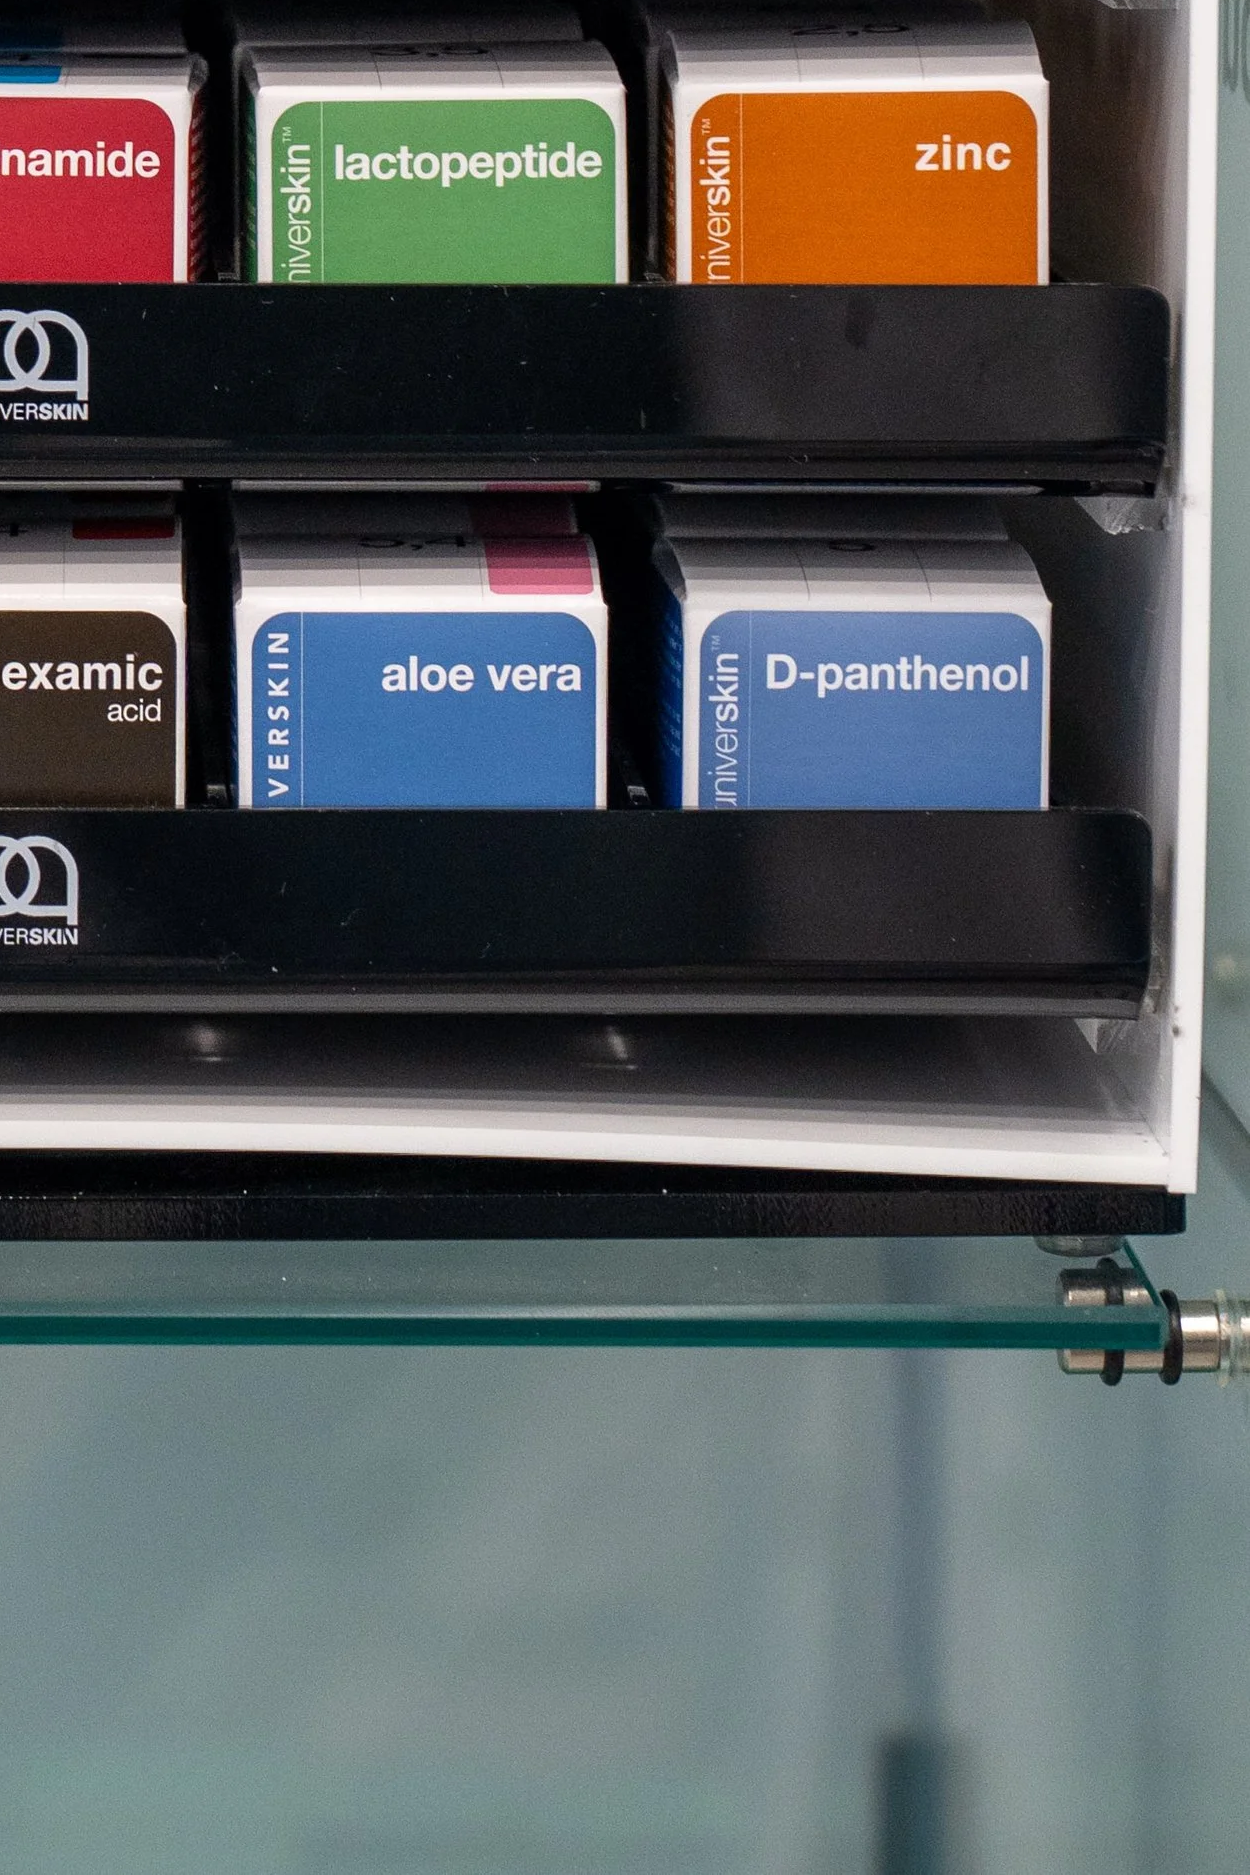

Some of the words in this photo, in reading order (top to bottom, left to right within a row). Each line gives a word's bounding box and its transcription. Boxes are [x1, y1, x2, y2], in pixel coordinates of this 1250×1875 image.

[335, 142, 602, 187] lactopeptide
[915, 135, 1012, 171] zinc
[381, 655, 474, 692] aloe
[486, 664, 582, 692] vera
[766, 654, 1029, 698] D-panthenol
[107, 699, 161, 722] acid
[267, 632, 289, 797] VERSKIN
